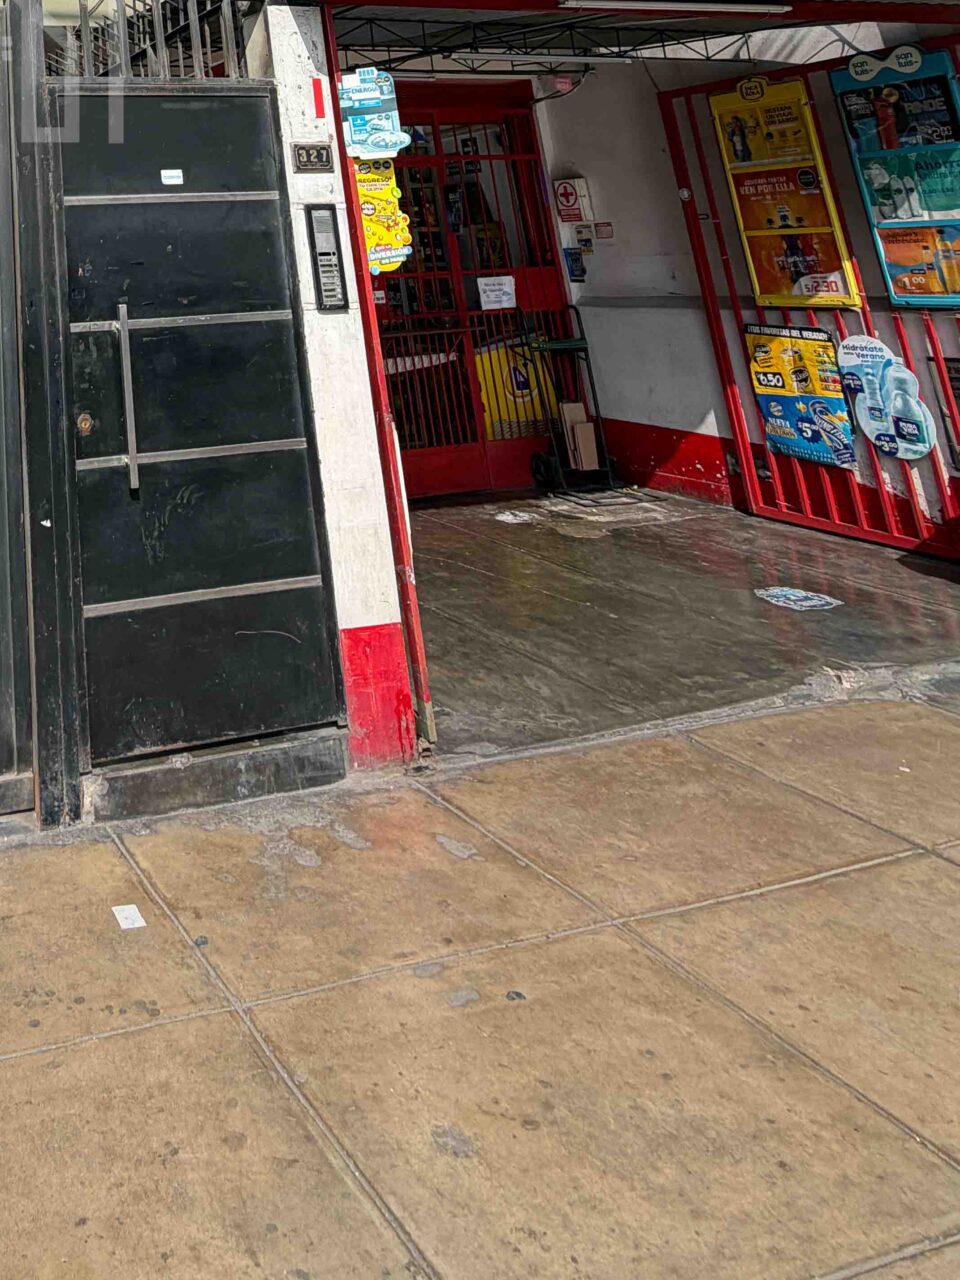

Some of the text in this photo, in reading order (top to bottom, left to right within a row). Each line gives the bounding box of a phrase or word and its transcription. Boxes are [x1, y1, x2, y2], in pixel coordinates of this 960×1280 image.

[298, 149, 328, 163] 327
[739, 184, 756, 195] VEN
[855, 352, 886, 360] Verano
